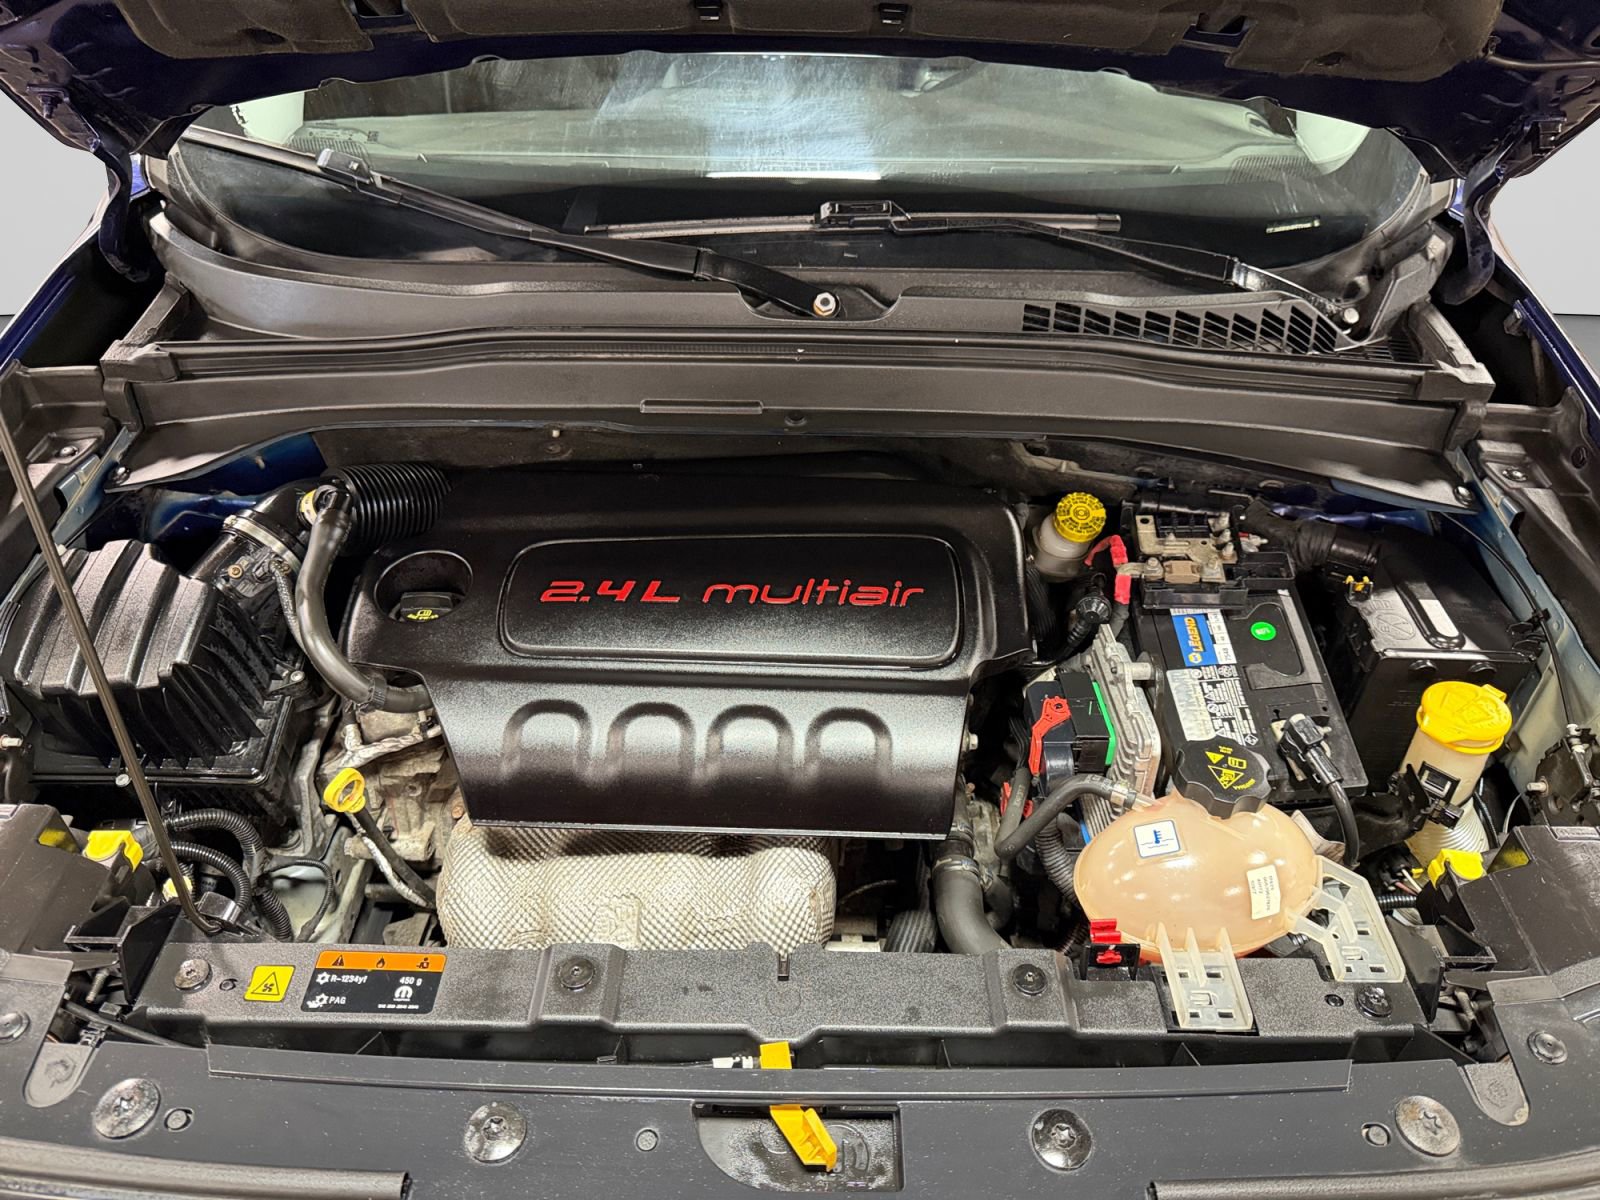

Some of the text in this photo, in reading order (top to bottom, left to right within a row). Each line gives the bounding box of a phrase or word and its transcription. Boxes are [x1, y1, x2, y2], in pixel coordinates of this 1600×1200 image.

[702, 578, 924, 607] multiair
[330, 974, 368, 985] R-1234yf
[399, 976, 415, 985] 450
[328, 996, 346, 1005] PAG
